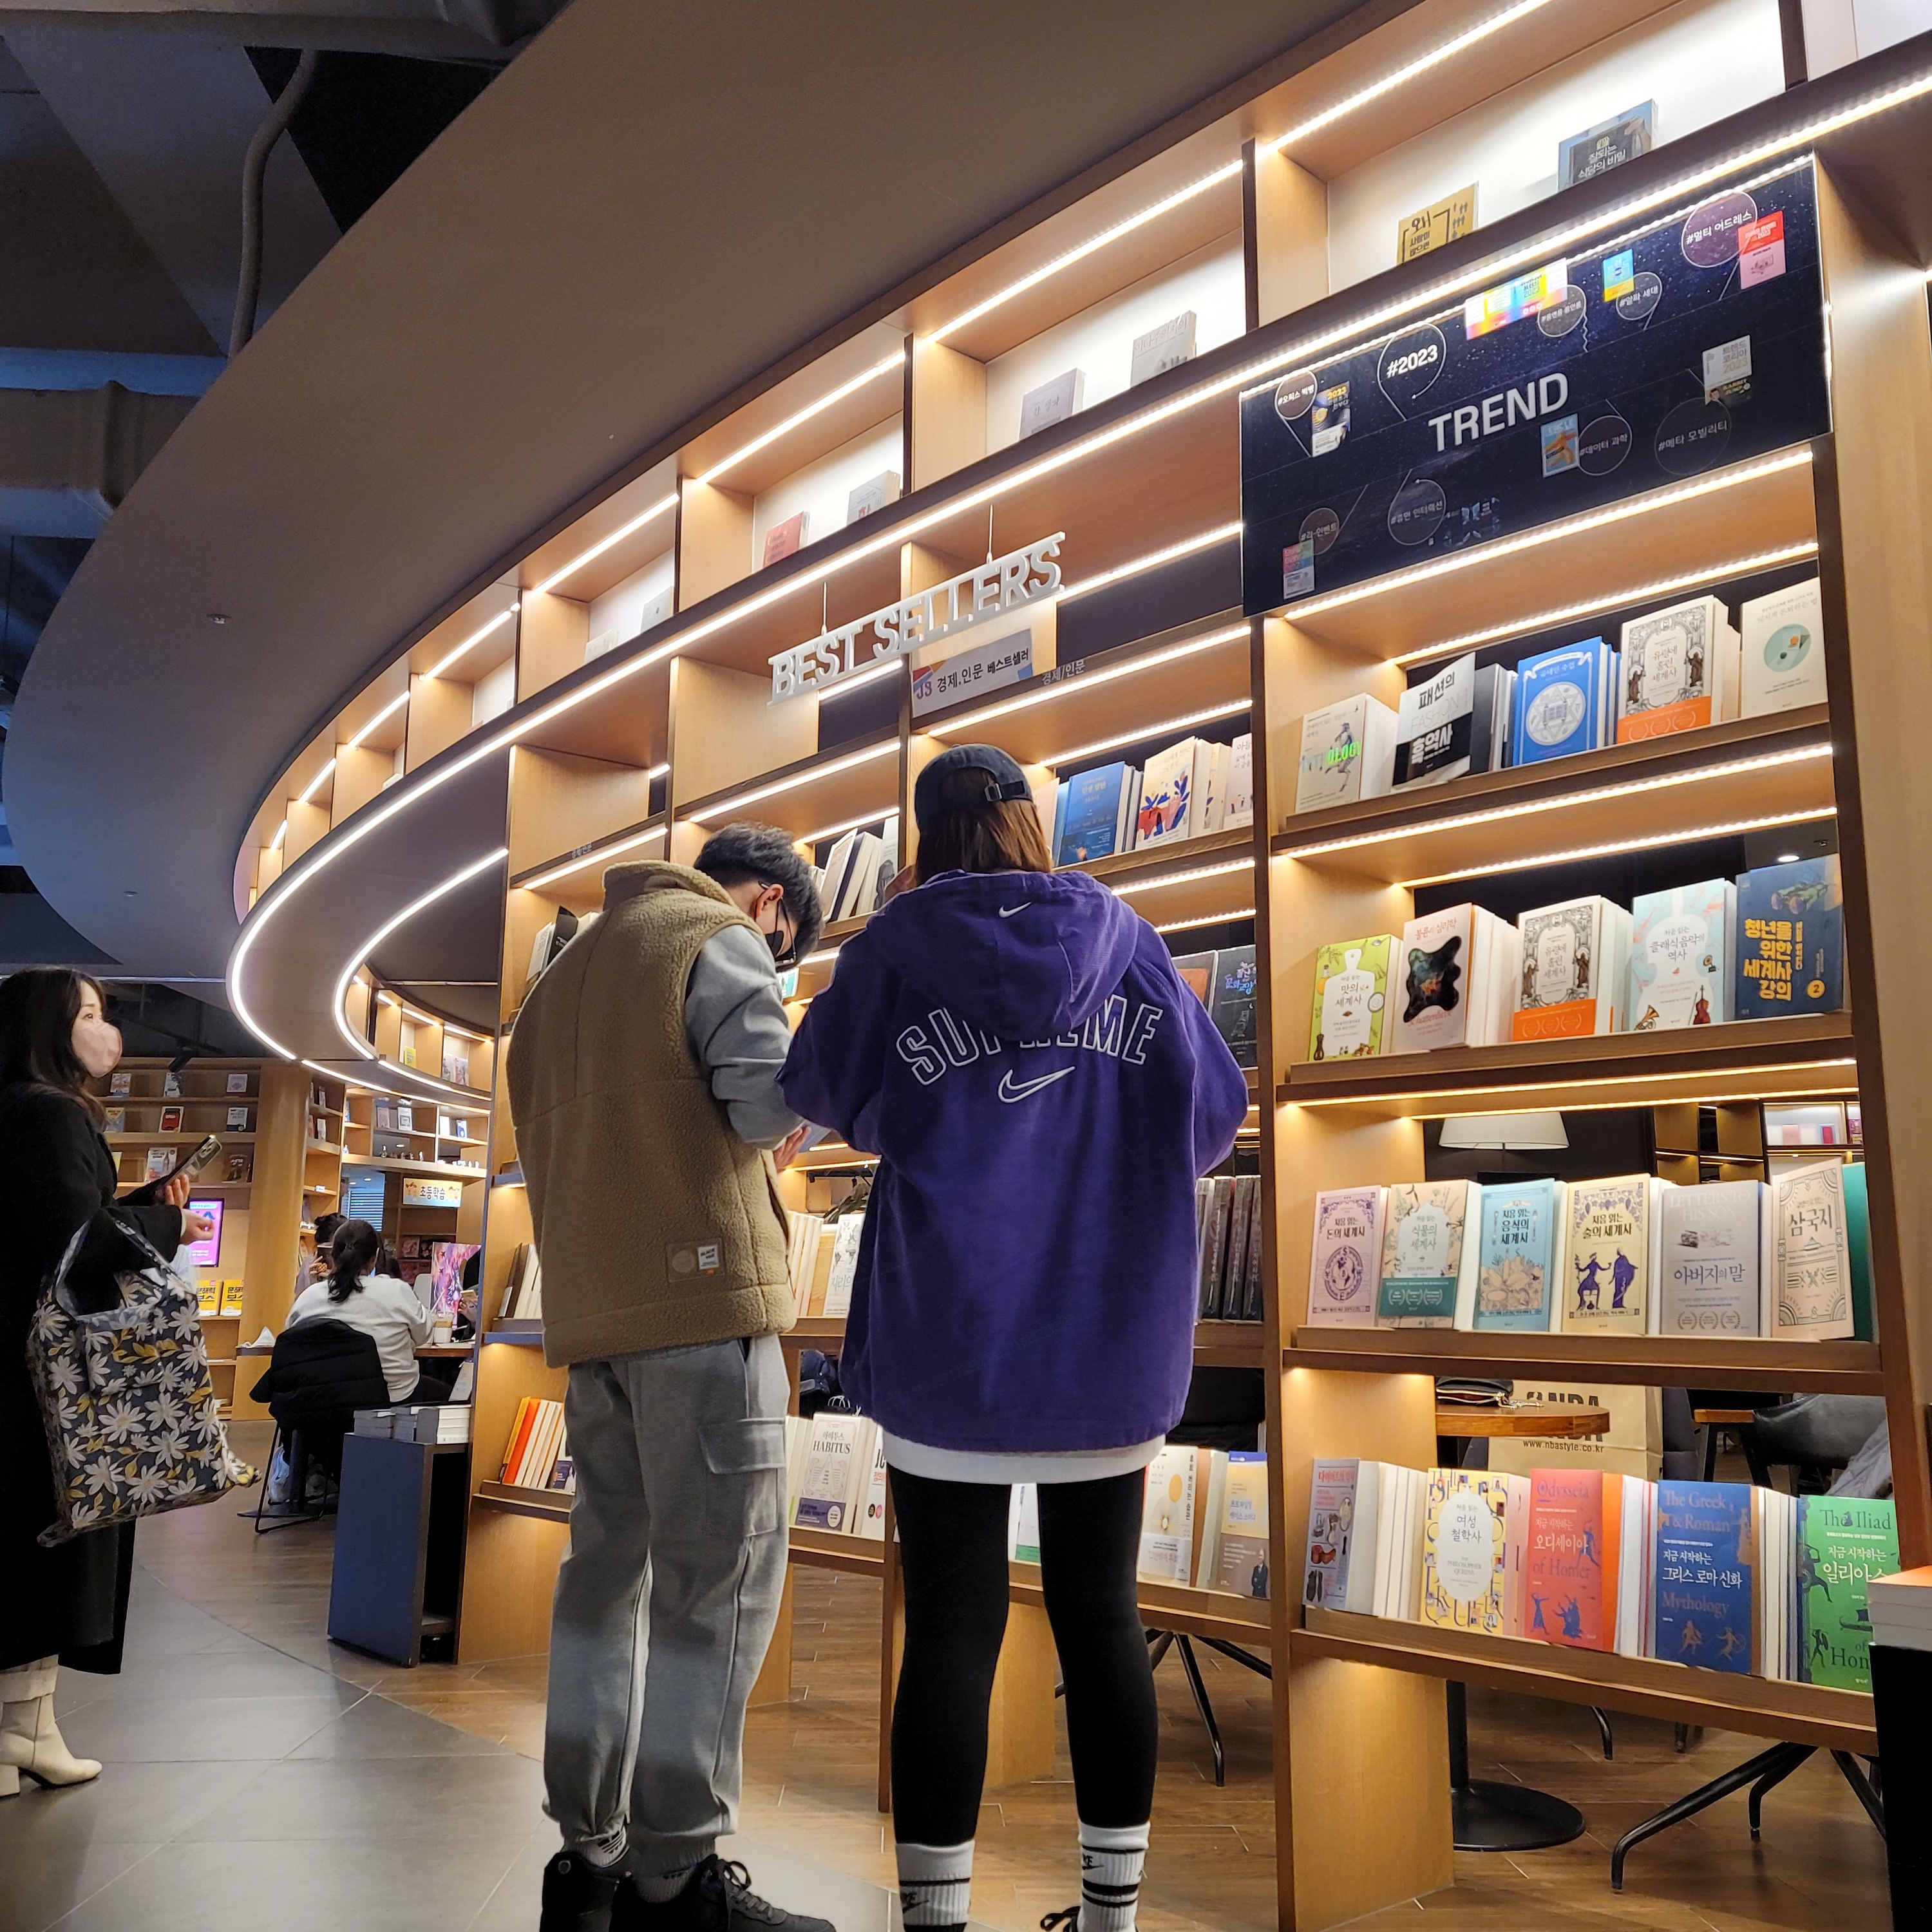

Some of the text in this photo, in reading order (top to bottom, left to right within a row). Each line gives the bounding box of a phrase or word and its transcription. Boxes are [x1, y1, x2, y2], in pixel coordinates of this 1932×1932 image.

[1588, 144, 1617, 162] 잘되는
[1578, 149, 1626, 179] 식당의 비밀
[1686, 226, 1713, 245] #멀티
[1714, 209, 1753, 232] 어드레스
[1386, 345, 1438, 379] #2023
[1723, 348, 1747, 364] 코리아
[1723, 357, 1748, 374] 2023
[1278, 391, 1302, 406] #오피스
[1428, 372, 1569, 453] TREND
[1658, 419, 1728, 451] #메타 모빌리티
[772, 539, 1063, 697] BEST SELLERS
[916, 647, 1030, 701] J3 경제.인문 베스트셀러
[1042, 659, 1086, 686] 경제/인문
[1651, 667, 1677, 683] 세계사
[1418, 671, 1455, 709] 패션의
[1412, 723, 1454, 765] 흑역사
[1435, 917, 1458, 934] 심리학
[1745, 918, 1792, 941] 청년을
[1667, 947, 1688, 963] 역사
[1759, 940, 1792, 961] 위한
[1543, 965, 1567, 980] 세계사
[1743, 958, 1792, 981] 세계사
[1340, 981, 1359, 996] 맛의
[1759, 979, 1792, 1001] 강의
[1334, 994, 1363, 1009] 세계사
[896, 994, 1164, 1086] SUME
[419, 1185, 446, 1200] 초등학습
[1669, 1189, 1751, 1208] LETTERS TO
[1334, 1216, 1359, 1227] 처음 읽는
[1502, 1208, 1532, 1219] 처음 읽는
[1592, 1213, 1624, 1226] 처음 읽는
[1682, 1205, 1738, 1222] HIS SON
[1788, 1204, 1833, 1237] 삼국지
[1326, 1226, 1366, 1240] 돈의 세계사
[1411, 1223, 1437, 1237] 식물의
[1501, 1218, 1530, 1232] 음식의
[1582, 1223, 1633, 1240] 술의 세계사
[1410, 1238, 1437, 1251] 세계사
[1500, 1231, 1529, 1245] 세계사
[1674, 1263, 1746, 1287] 아버지의 말
[813, 1440, 851, 1455] HABITUS
[1522, 1439, 1604, 1454] www.nbastyle.co.kr
[1537, 1480, 1590, 1501] Odysseia
[1663, 1490, 1727, 1510] The Greek
[1457, 1514, 1477, 1529] 여성
[1535, 1517, 1575, 1531] 지금 시작하는
[1685, 1513, 1731, 1533] Roman
[1820, 1509, 1892, 1530] The Iliad
[1451, 1529, 1482, 1544] 철학사
[1533, 1533, 1589, 1555] 오디세이아
[1663, 1549, 1714, 1566] 지금 시작하는
[1828, 1545, 1888, 1563] 지금 시작하는
[1447, 1560, 1482, 1570] PHILOSOPHER
[1454, 1568, 1476, 1577] QUEENS
[1532, 1557, 1592, 1580] of Homer
[1662, 1566, 1743, 1590] 그리스 로마 신화
[1662, 1590, 1731, 1619] Mythology
